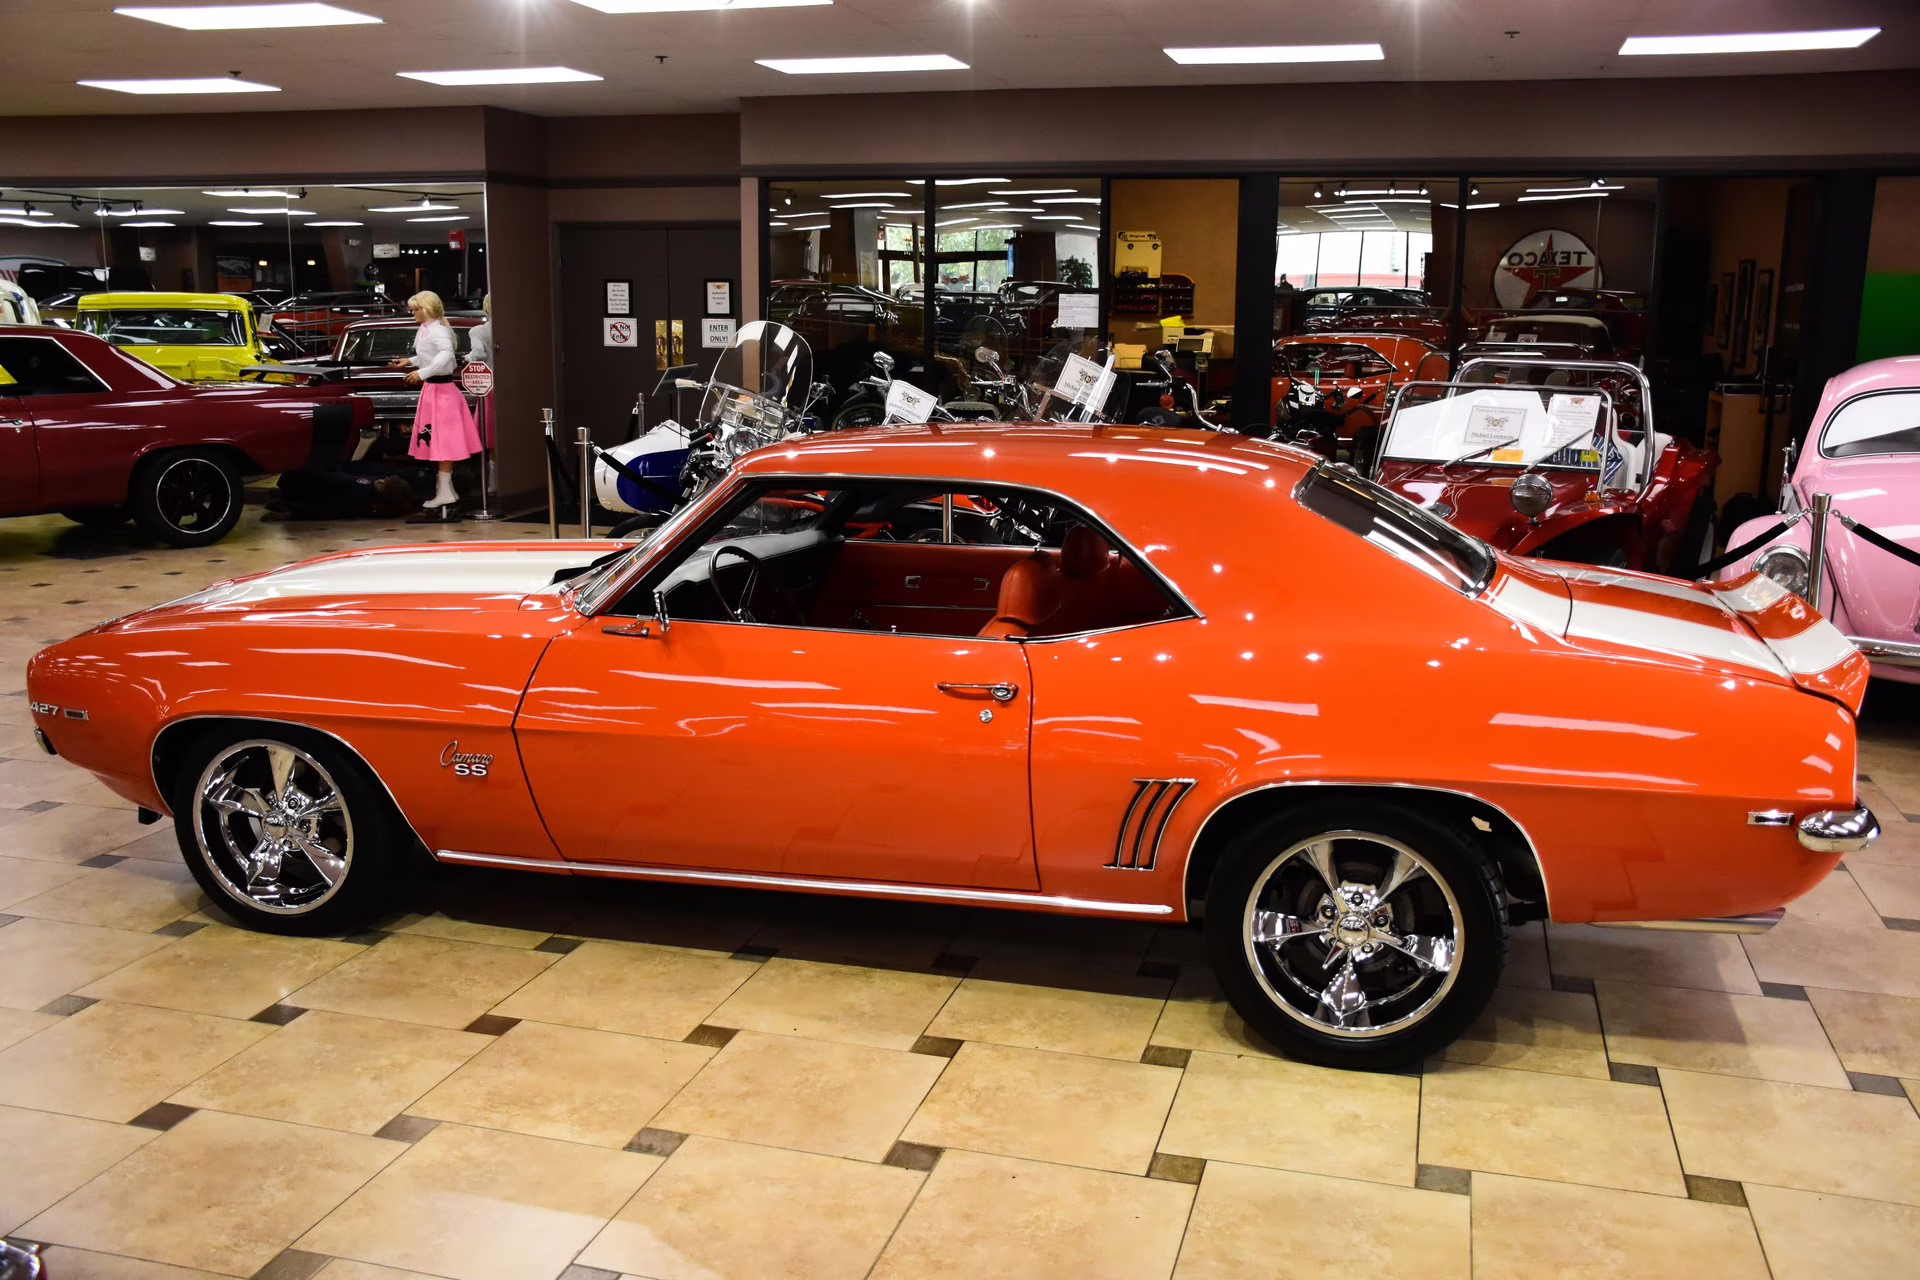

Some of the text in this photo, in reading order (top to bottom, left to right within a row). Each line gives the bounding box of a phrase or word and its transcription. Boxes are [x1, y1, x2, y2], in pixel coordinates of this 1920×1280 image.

[469, 364, 486, 372] STOP
[31, 701, 60, 716] 427
[440, 740, 494, 766] Camaro
[454, 763, 487, 776] SS
